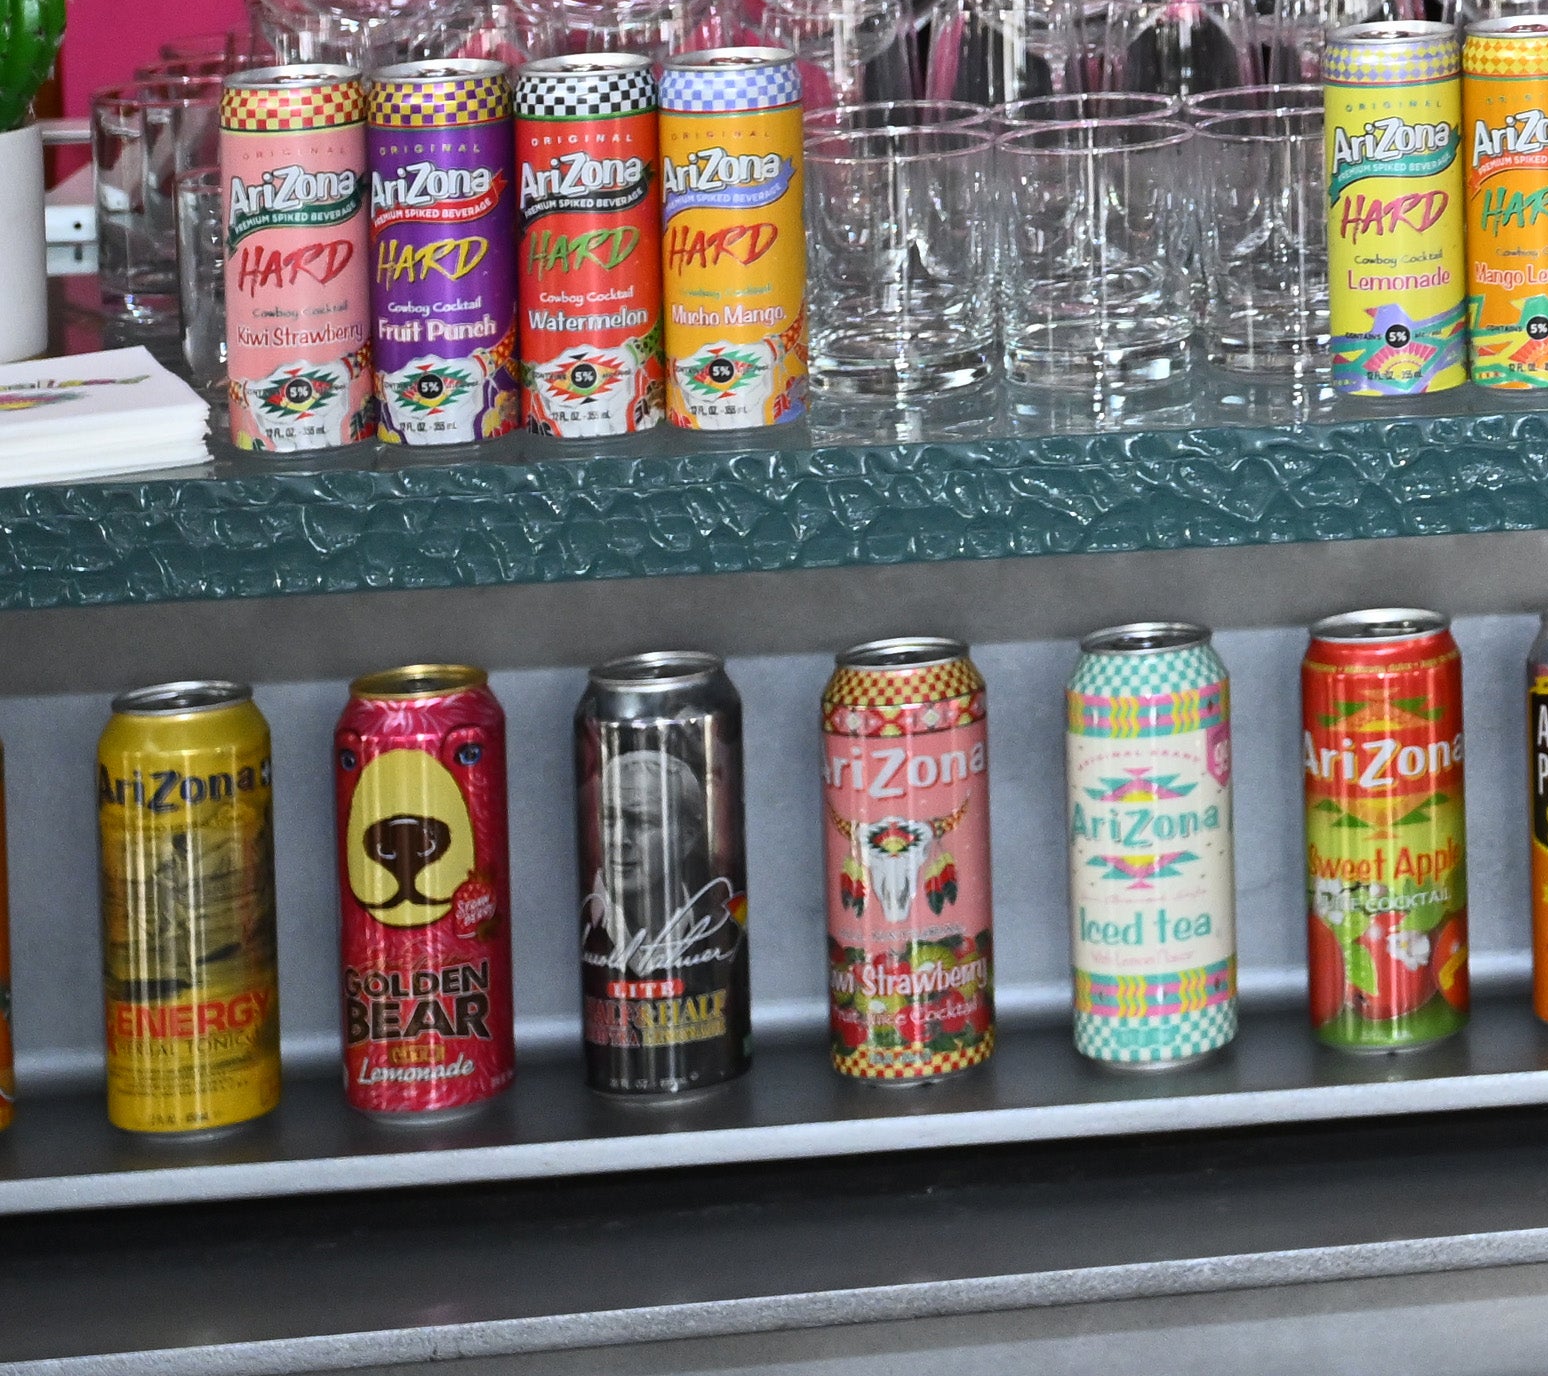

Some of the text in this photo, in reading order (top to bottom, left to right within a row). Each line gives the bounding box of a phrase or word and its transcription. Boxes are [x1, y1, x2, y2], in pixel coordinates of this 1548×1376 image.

[379, 143, 480, 156] ORIGINAL
[531, 133, 633, 147] ORIGINAL
[1332, 116, 1450, 177] AriZona
[371, 161, 491, 219] AriZona
[520, 151, 643, 209] AriZona
[663, 147, 781, 203] AriZona
[229, 165, 356, 226] AriZona
[374, 198, 492, 227] PREMIUM SPIKED BEVERAGE
[524, 199, 557, 219] PREMIUM
[558, 198, 595, 209] SPIKED
[596, 188, 643, 208] BEVERAGE
[234, 199, 356, 234] PREMIUM SPIKED BEVERAGE
[1340, 190, 1449, 245] HARD
[238, 239, 354, 298] HARD
[376, 235, 488, 291] HARD
[527, 225, 640, 282] HARD
[668, 222, 778, 276] HARD
[1347, 267, 1451, 291] Lemonade
[1475, 261, 1525, 290] Mango
[388, 296, 482, 317] Cowboy Cocktail
[540, 286, 634, 307] Cowboy Cocktail
[672, 304, 721, 327] Mucho
[237, 322, 363, 347] Kiwi Strawberry
[378, 313, 497, 342] Fruit Punch
[528, 307, 648, 332] Watermelon
[1073, 800, 1220, 849] AriZona
[1308, 843, 1387, 883] Sweet
[1365, 889, 1450, 913] COCKTAIL
[1079, 906, 1212, 946] Iced tea
[345, 957, 490, 999] GOLDEN
[613, 981, 675, 999] LITE
[862, 957, 988, 997] Strawberry
[116, 988, 271, 1038] ENERGY
[348, 993, 493, 1045] BEAR
[357, 1052, 476, 1085] Lemonade
